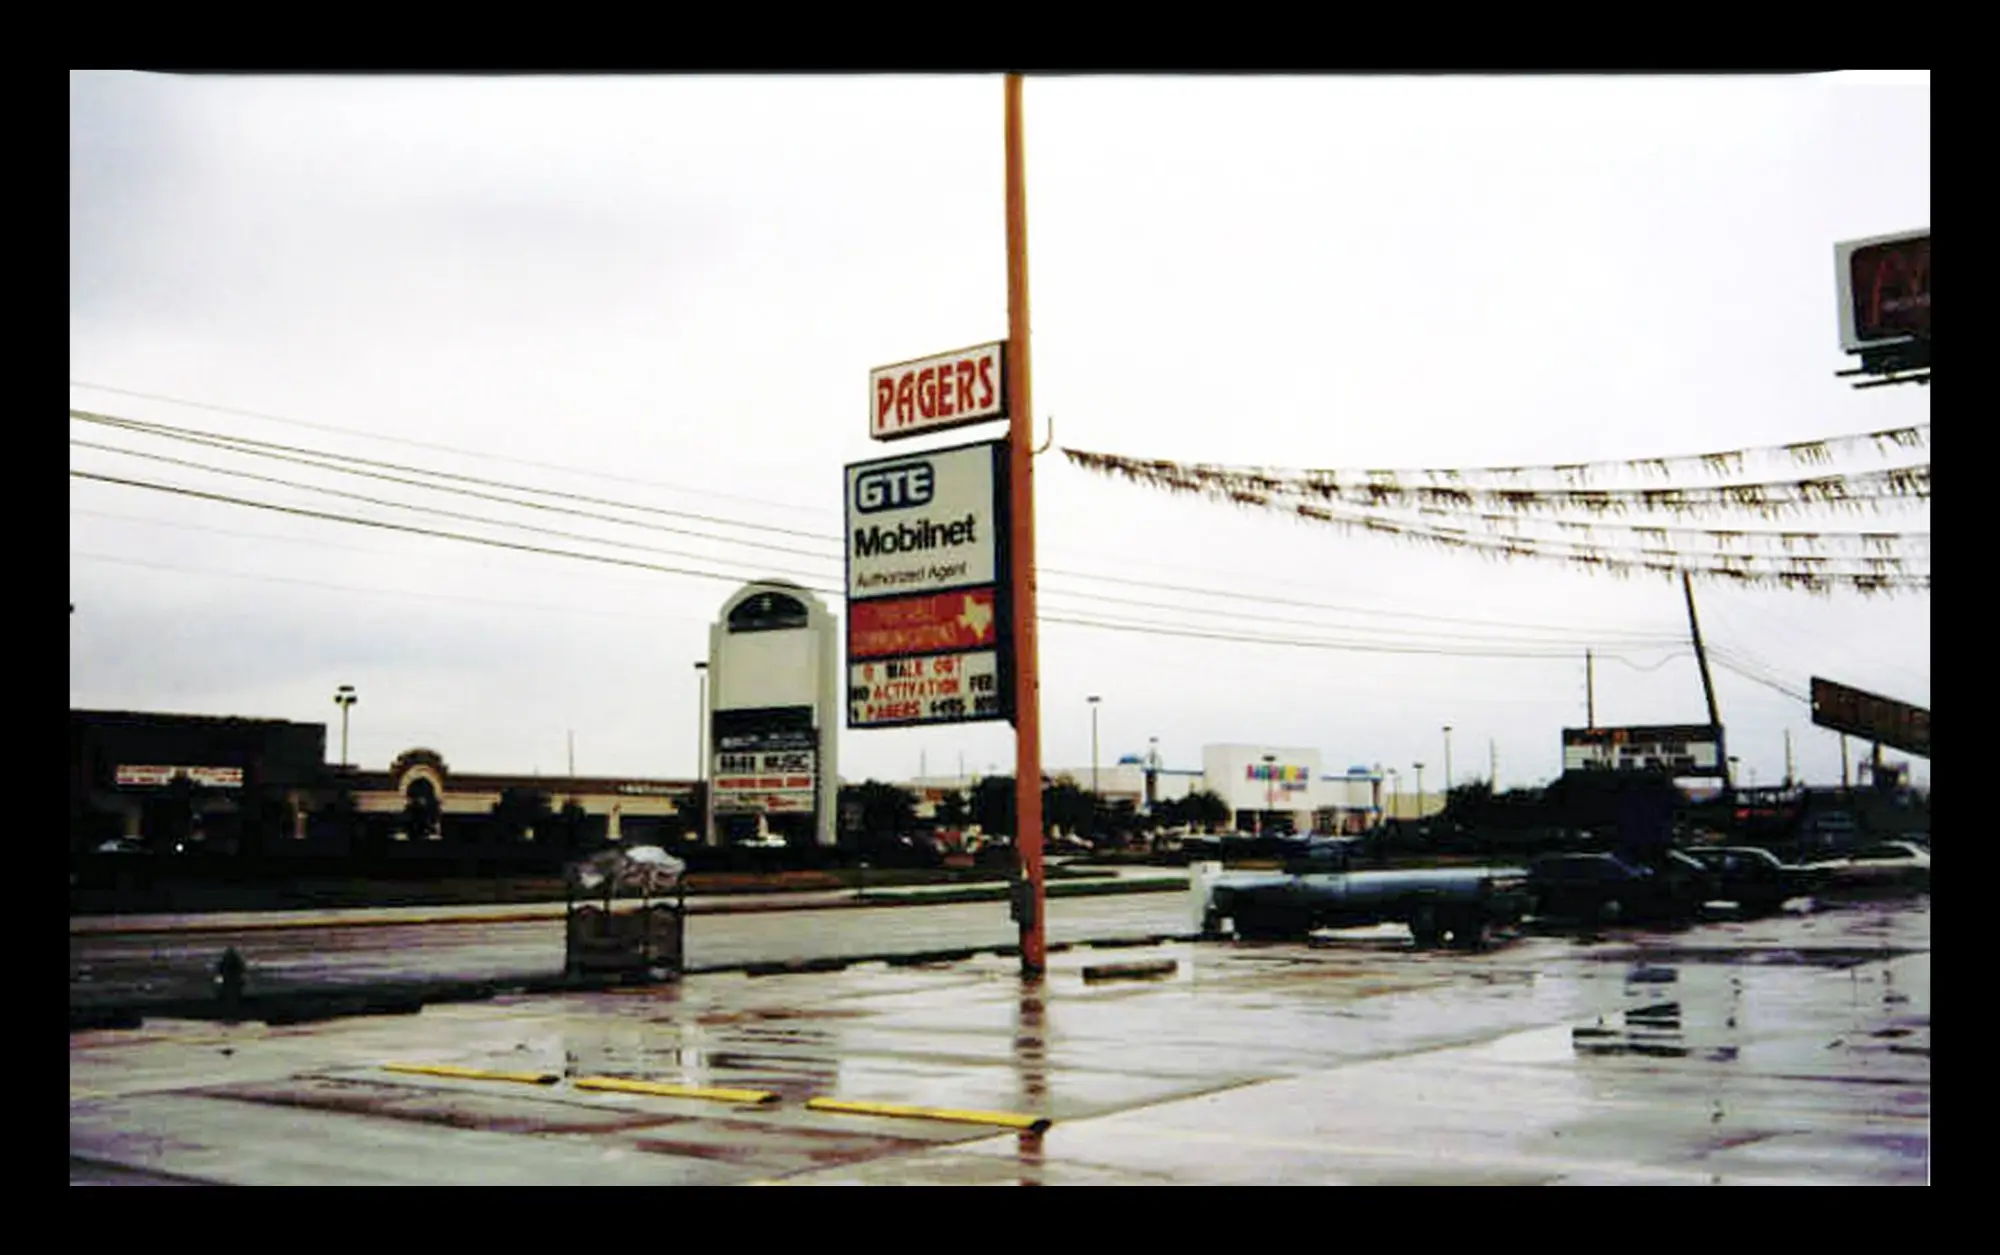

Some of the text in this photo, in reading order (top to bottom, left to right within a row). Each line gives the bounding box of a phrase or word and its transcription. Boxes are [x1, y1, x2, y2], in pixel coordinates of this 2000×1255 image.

[877, 355, 993, 430] PAGERS
[859, 466, 930, 508] GTE
[855, 513, 976, 558] Mobilnet
[857, 561, 967, 588] Authorized Agent
[873, 678, 959, 700] ACTIVATION
